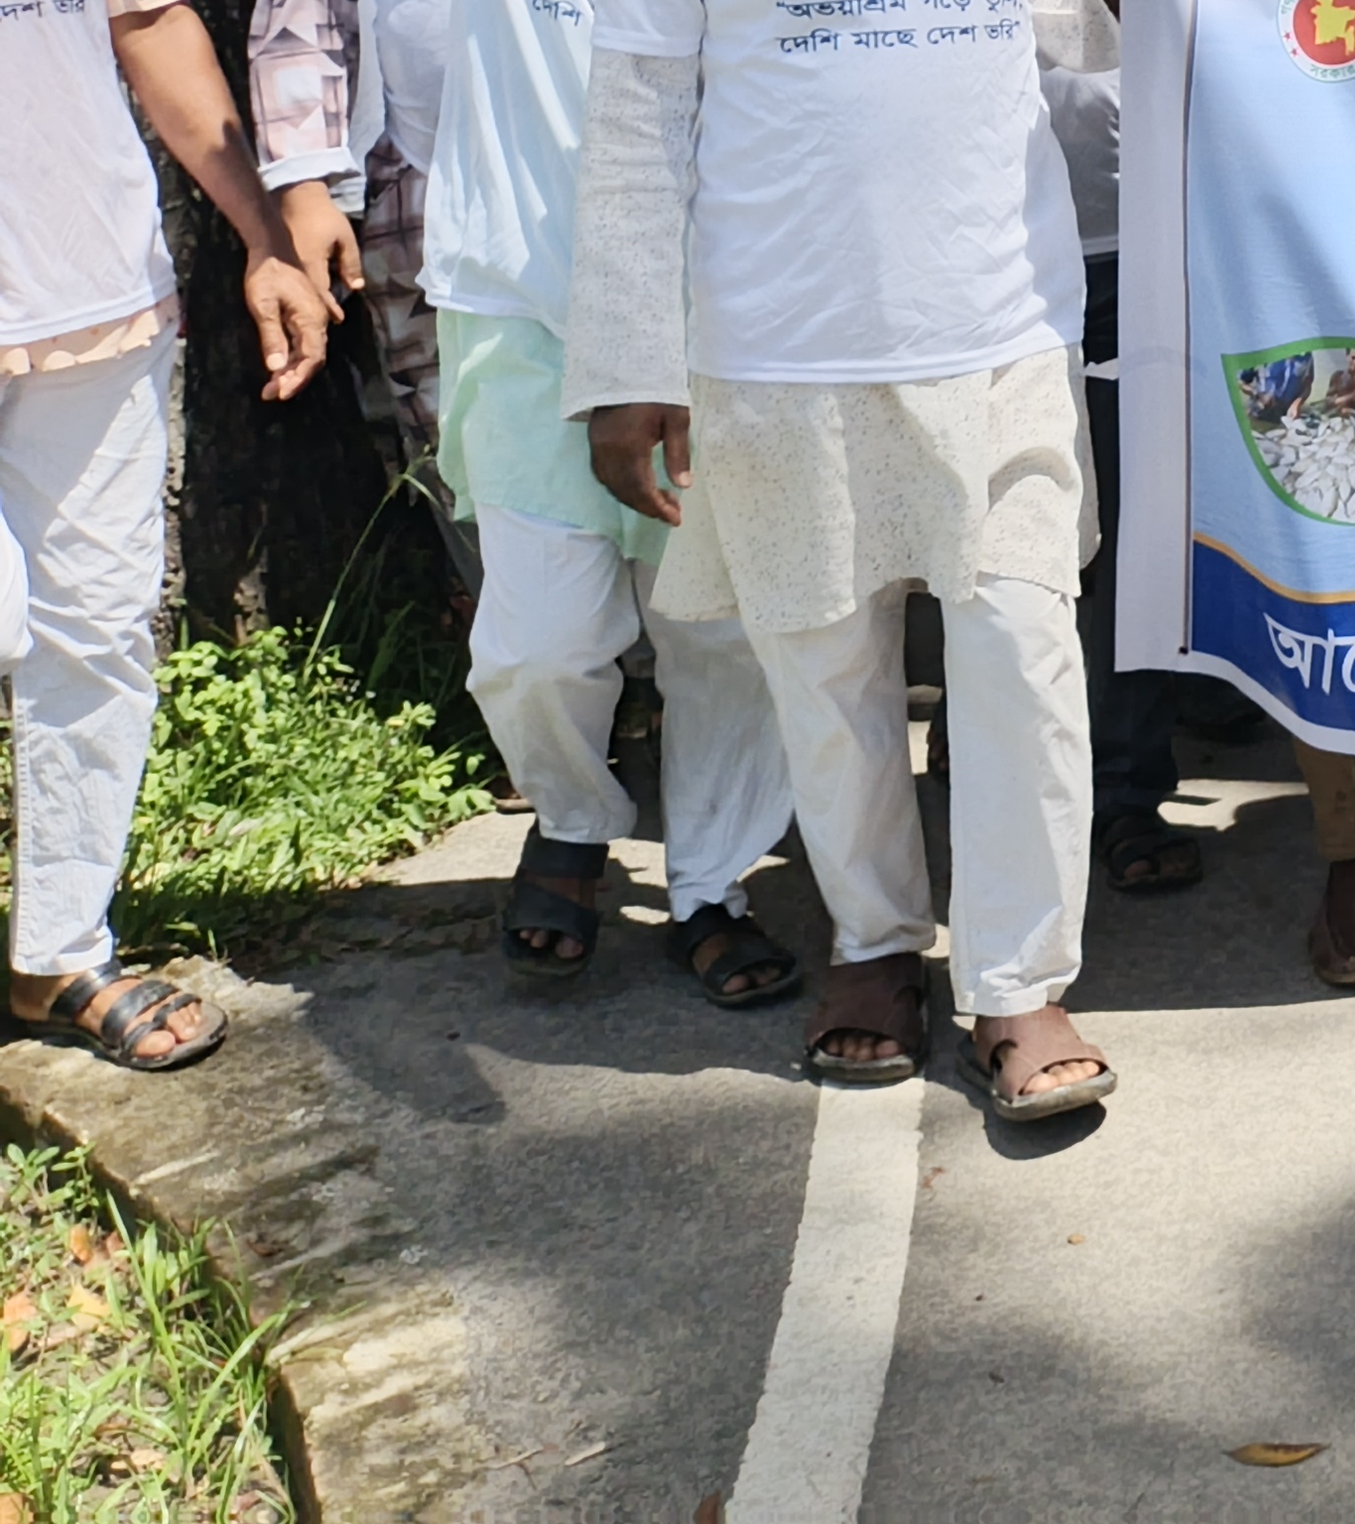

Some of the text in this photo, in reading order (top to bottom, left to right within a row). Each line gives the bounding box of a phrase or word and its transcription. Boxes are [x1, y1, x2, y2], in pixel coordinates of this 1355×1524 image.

[775, 28, 841, 54] দেশি
[851, 29, 919, 49] মাছে
[927, 24, 978, 45] দেশ
